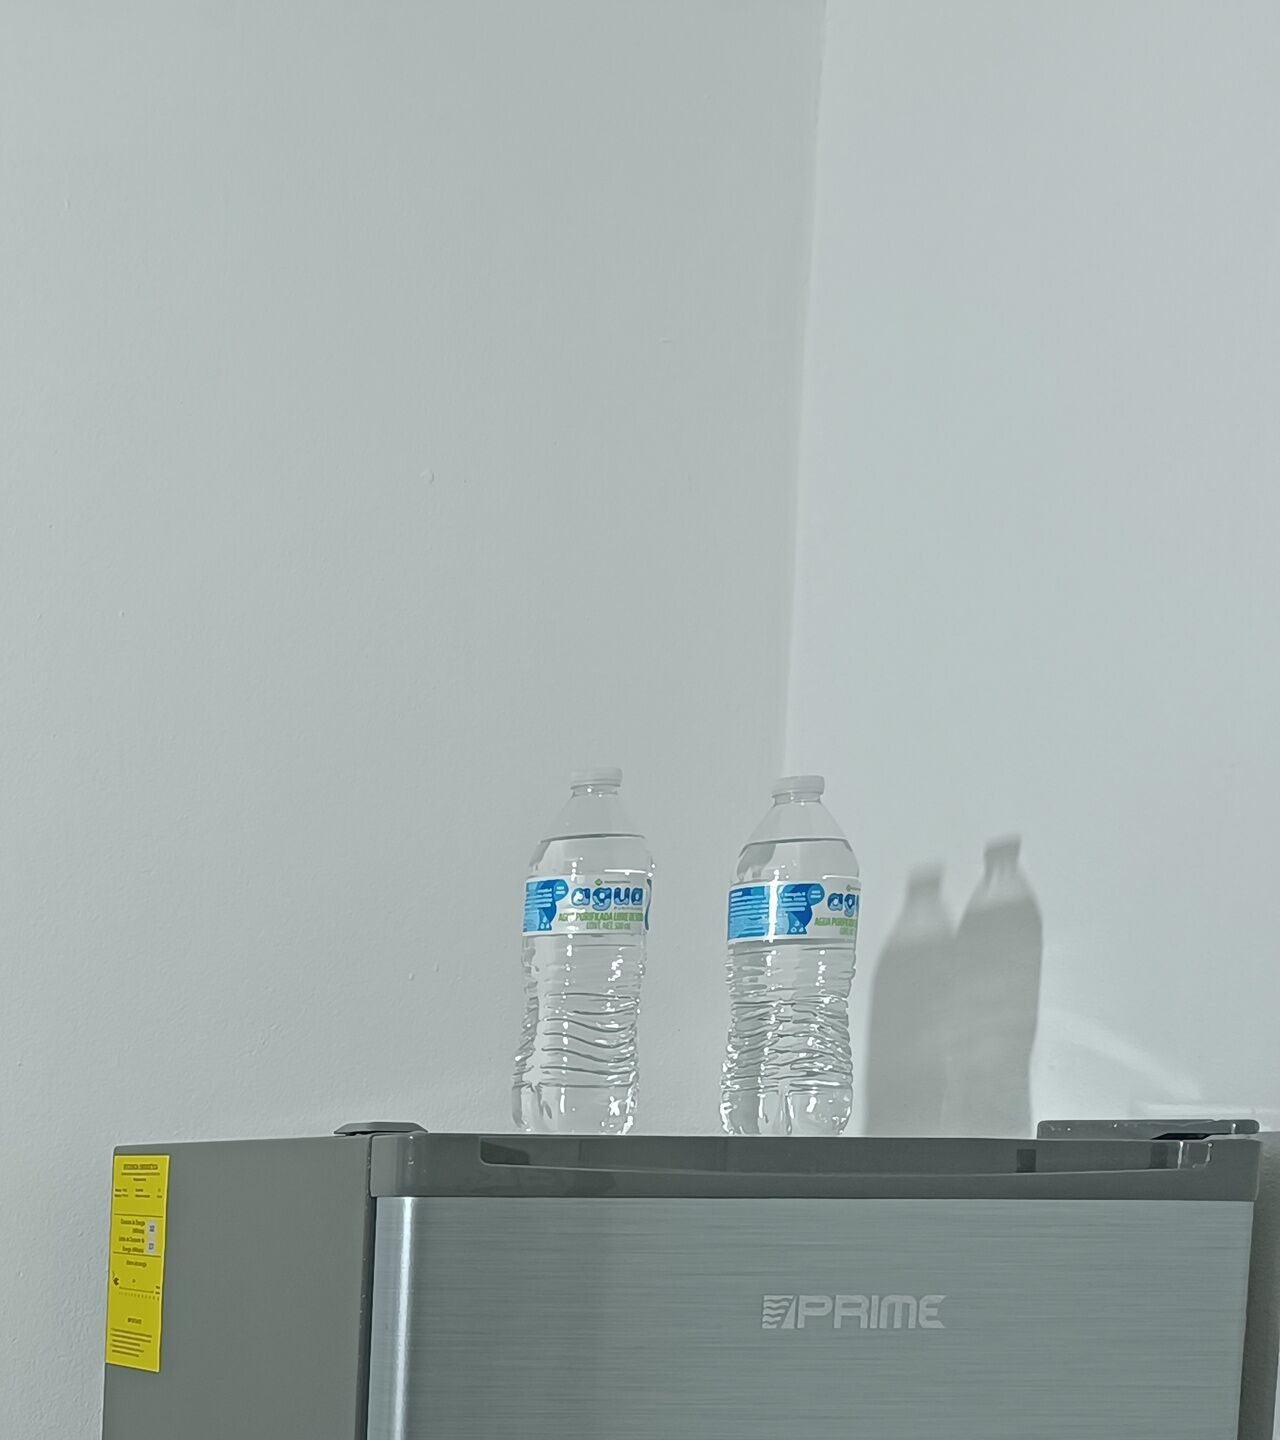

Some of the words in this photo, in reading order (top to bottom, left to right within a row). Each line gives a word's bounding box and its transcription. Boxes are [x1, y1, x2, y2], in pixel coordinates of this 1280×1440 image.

[571, 887, 644, 911] agua
[827, 892, 859, 917] ag
[797, 1294, 947, 1329] PRIME
